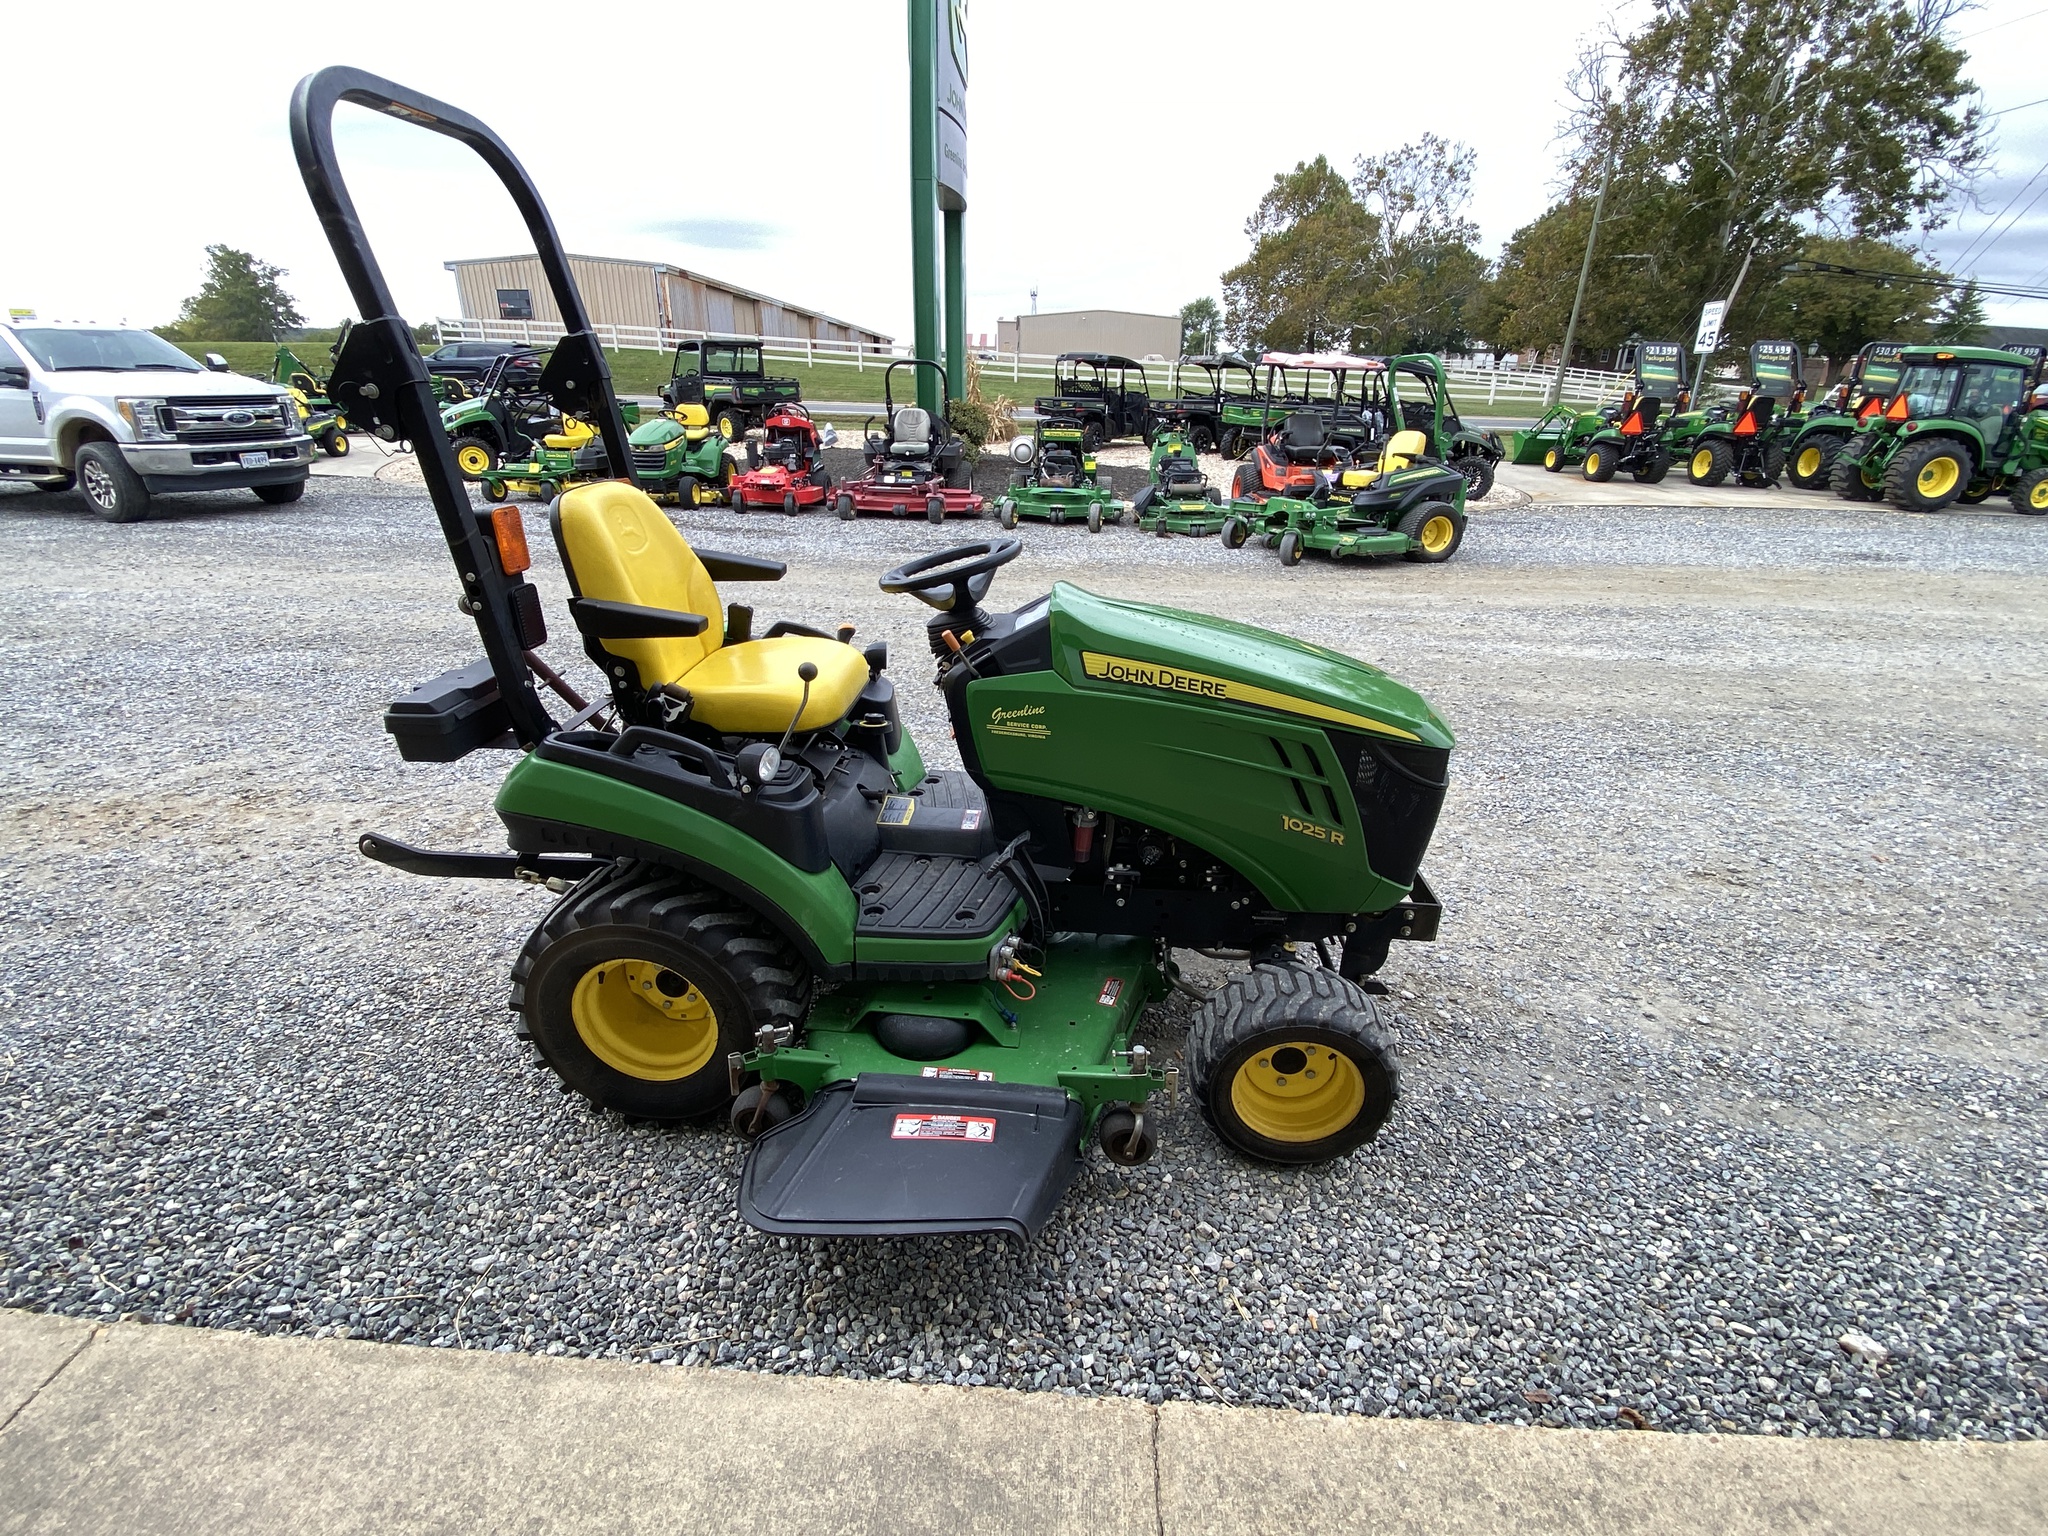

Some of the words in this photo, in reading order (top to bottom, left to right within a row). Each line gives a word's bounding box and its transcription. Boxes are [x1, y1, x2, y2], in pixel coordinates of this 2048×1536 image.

[1698, 331, 1716, 347] 45
[1099, 662, 1153, 684] JOHN
[1158, 670, 1227, 697] DEERE
[991, 704, 1046, 725] Greenline
[1006, 721, 1030, 729] SERVICE
[1281, 814, 1327, 840] 1025
